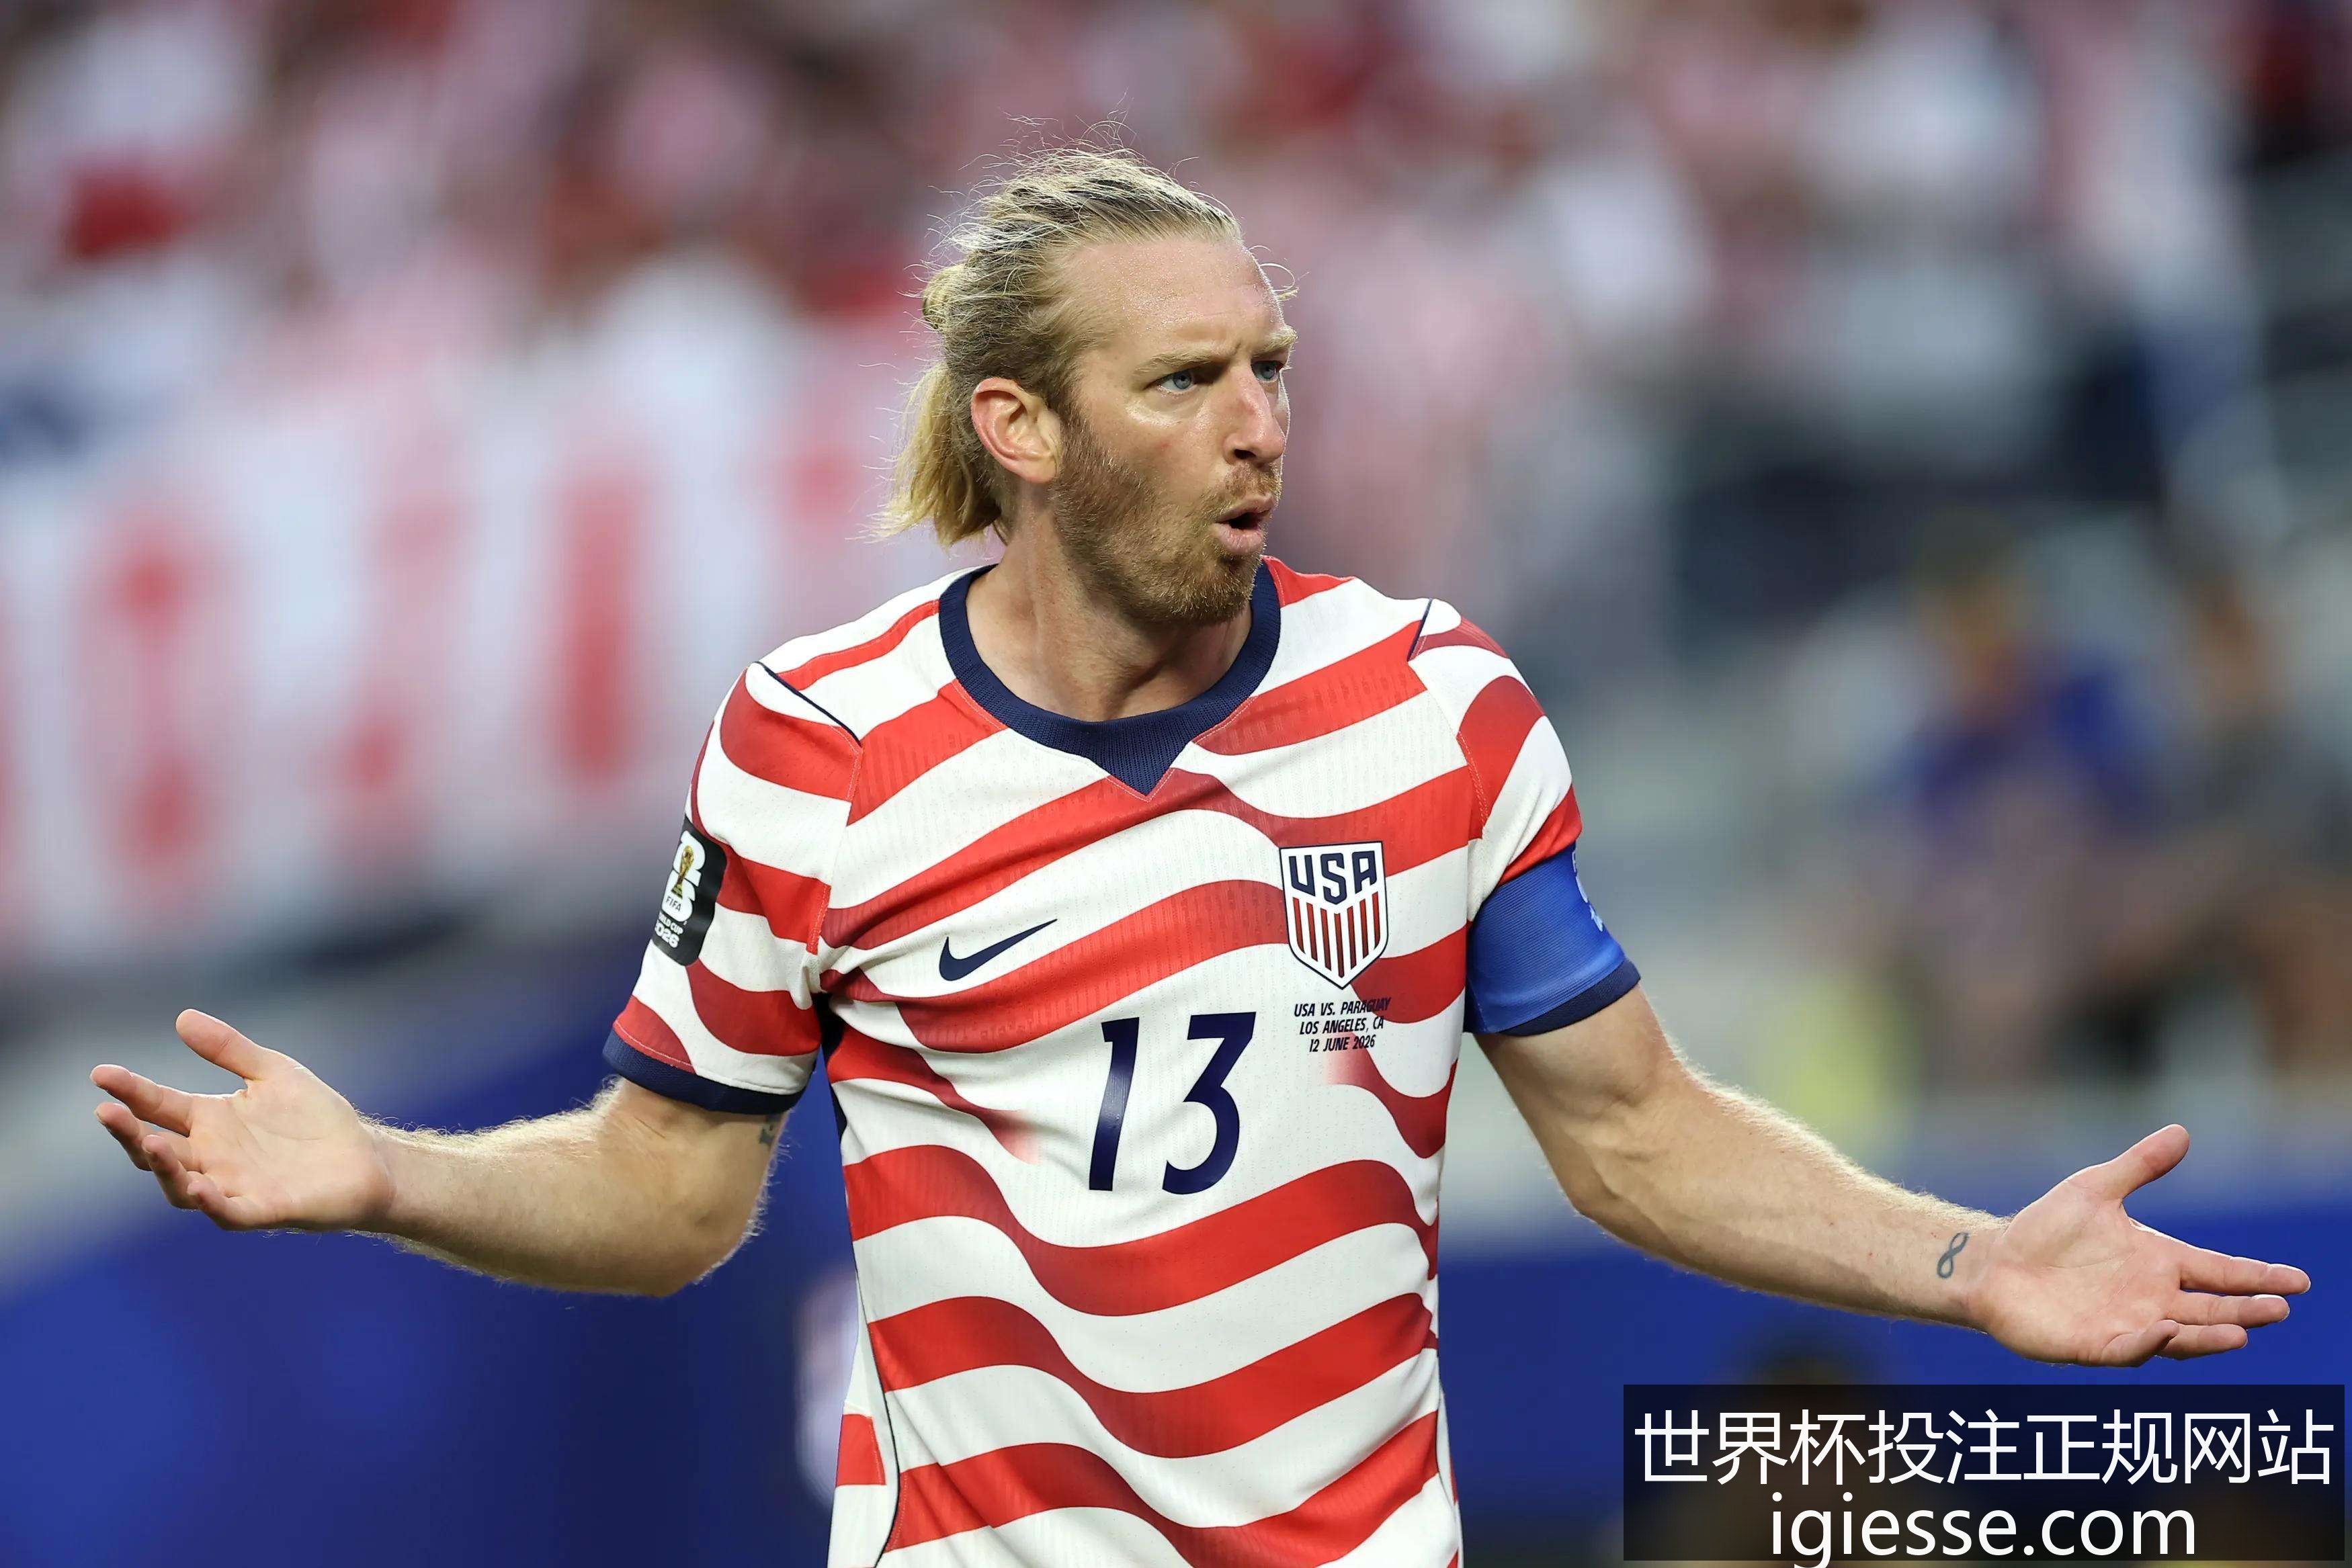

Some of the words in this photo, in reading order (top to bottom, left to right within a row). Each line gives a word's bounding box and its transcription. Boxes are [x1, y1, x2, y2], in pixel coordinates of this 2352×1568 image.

[1289, 851, 1378, 905] USA
[666, 896, 681, 912] FIFA
[670, 922, 683, 934] CUP
[1294, 1004, 1315, 1016] USA
[1320, 1002, 1335, 1016] VS.
[1341, 998, 1391, 1015] PARAGUAY
[1300, 1021, 1319, 1035] LOS
[1322, 1018, 1368, 1033] ANGELES,
[1373, 1015, 1384, 1029] CA
[1310, 1039, 1320, 1052] 12
[1323, 1037, 1349, 1051] JUNE
[1353, 1035, 1376, 1049] 2026
[1089, 1012, 1257, 1194] 13
